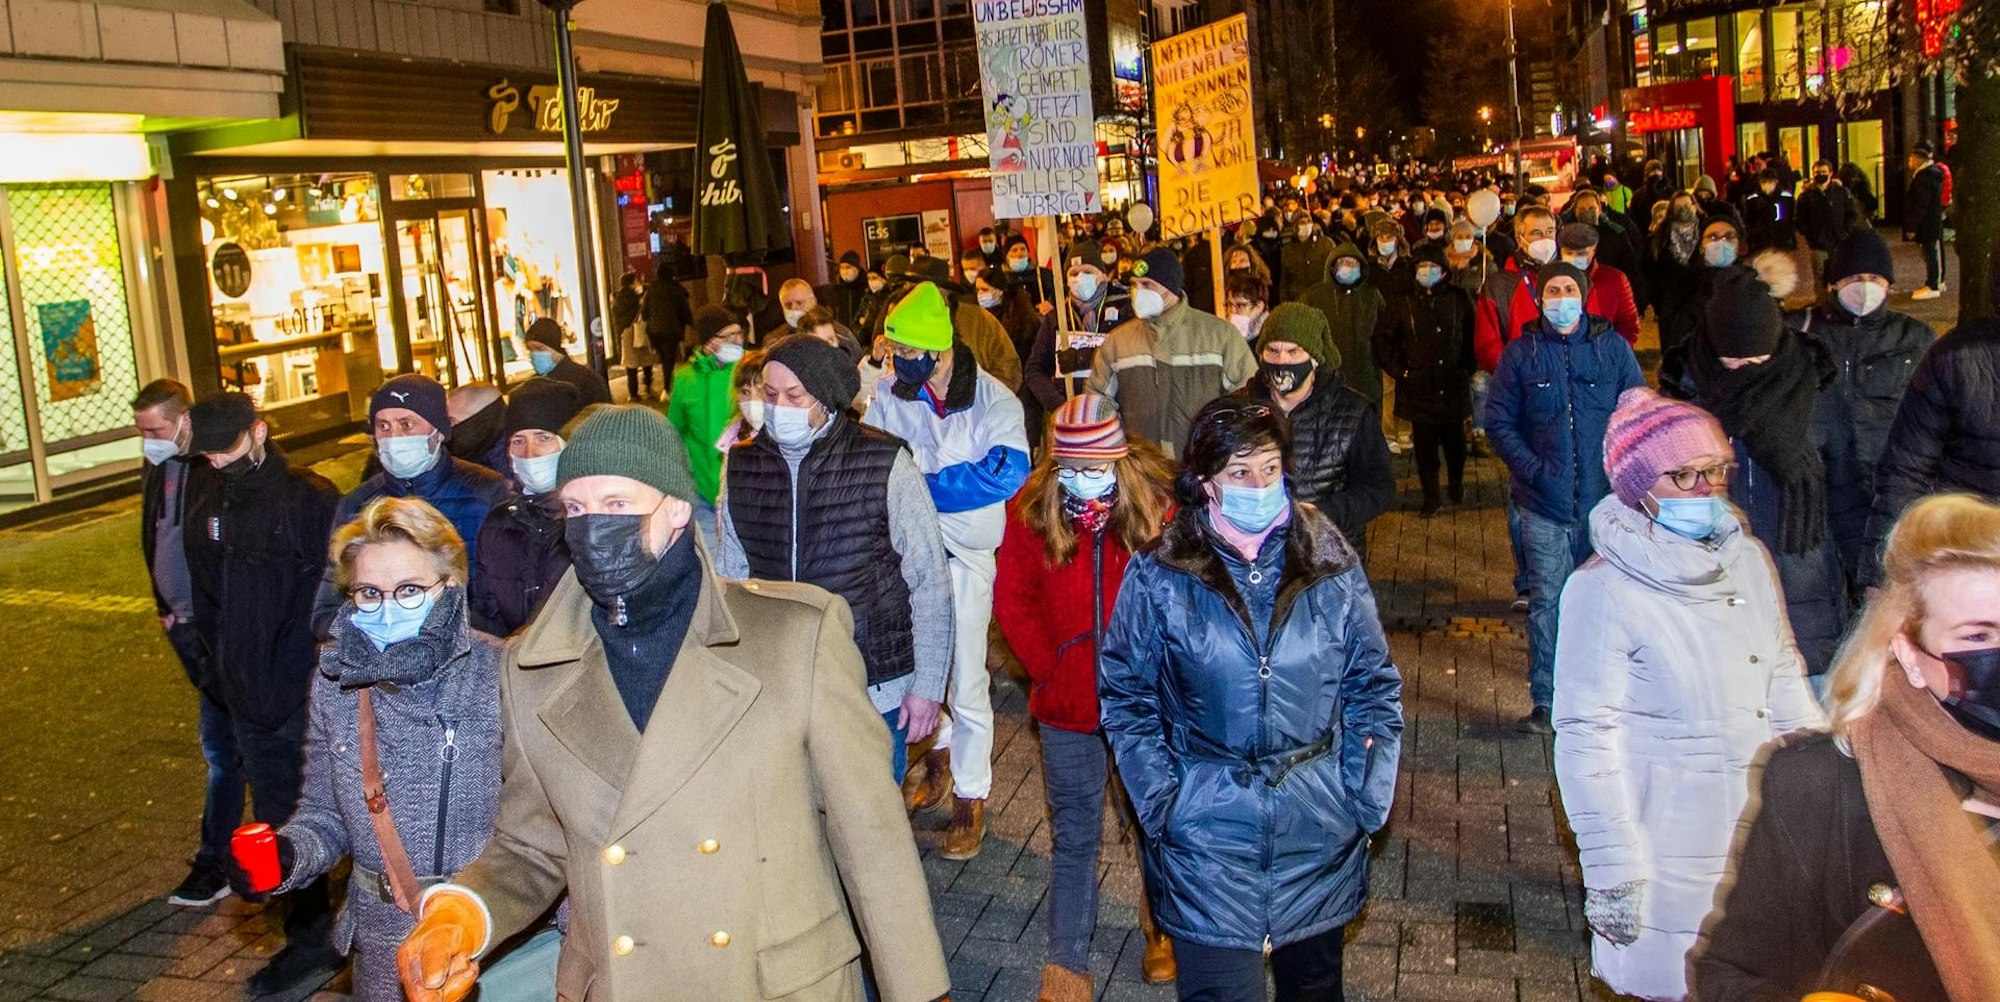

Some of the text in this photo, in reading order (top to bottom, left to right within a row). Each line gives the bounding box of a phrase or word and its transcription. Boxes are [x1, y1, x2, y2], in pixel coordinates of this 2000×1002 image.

[975, 0, 1083, 23] UNBEUGSAM
[1017, 41, 1085, 70] RÖMER
[1183, 64, 1249, 98] SPINNEN
[1029, 93, 1081, 121] JETZT
[1028, 118, 1077, 146] SIND
[1213, 117, 1242, 147] JA
[1029, 143, 1097, 173] NUR NOCH
[993, 169, 1089, 196] GALLIER
[1176, 178, 1211, 209] DIE
[1160, 192, 1260, 241] RÖMER
[867, 224, 890, 241] Ess
[281, 303, 341, 336] COFFEE
